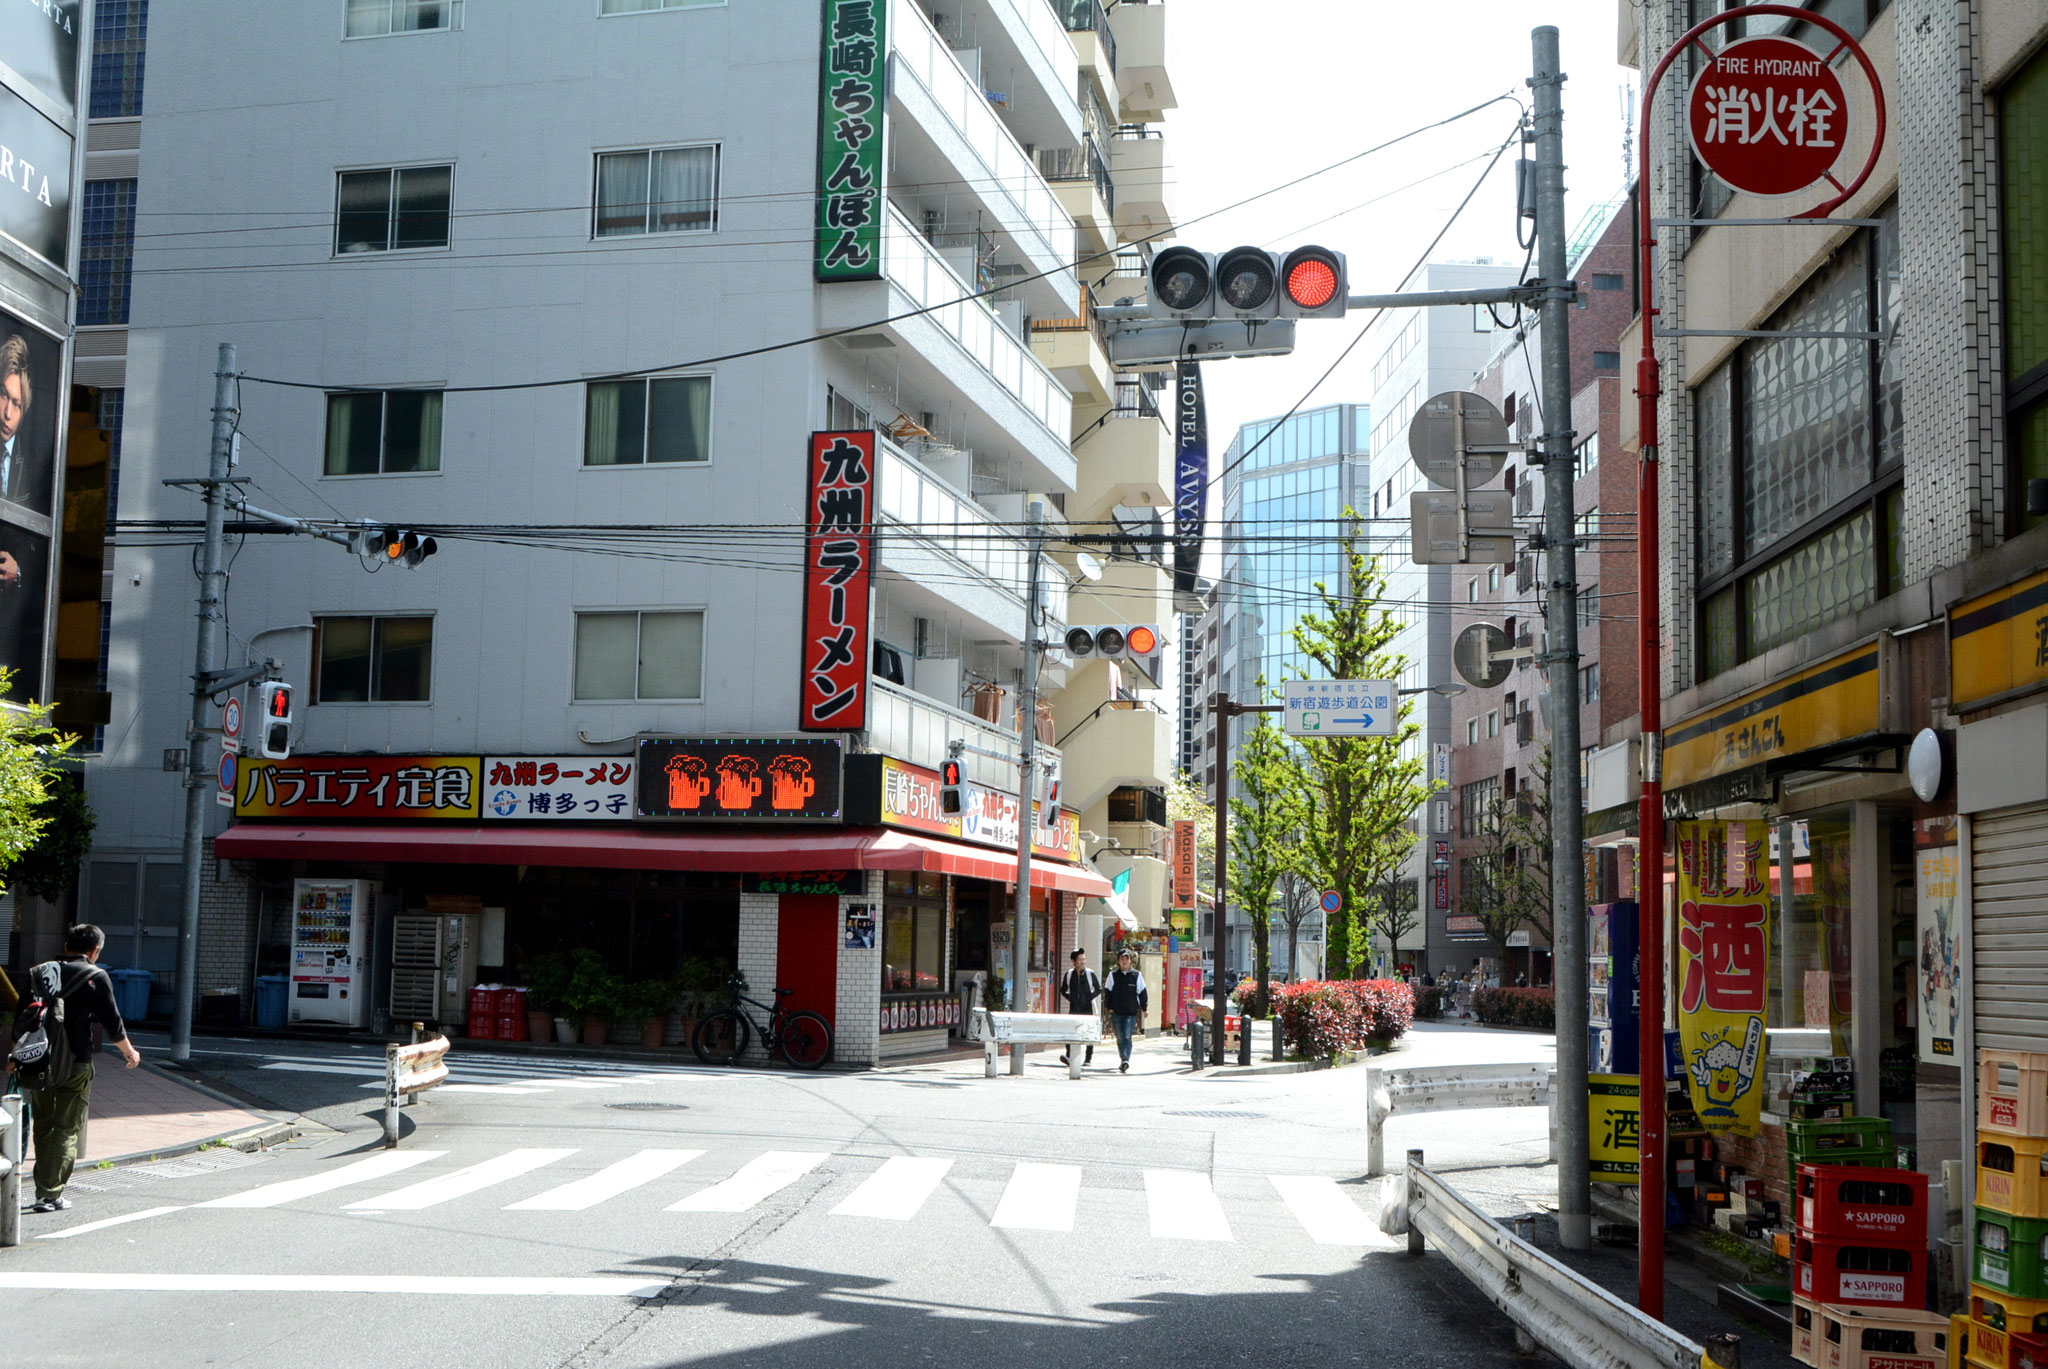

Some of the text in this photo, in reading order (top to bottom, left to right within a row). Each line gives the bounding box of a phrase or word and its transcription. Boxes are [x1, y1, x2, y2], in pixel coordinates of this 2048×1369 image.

[30, 0, 72, 35] RTA
[1717, 57, 1822, 77] FIRE HYDRANT
[1704, 85, 1837, 147] 消火栓
[825, 1, 877, 268] 長崎ちゃんぽん
[1182, 375, 1197, 447] HOTEL
[811, 437, 869, 722] 九州ラーメン
[228, 708, 238, 727] 30
[1289, 696, 1388, 710] 新宿遊歩道公園
[241, 765, 472, 809] バラエティ定食
[490, 761, 631, 786] 九州ラーメン
[528, 792, 629, 815] 博多っ子
[884, 766, 959, 826] 長崎ちゃん
[983, 789, 1019, 823] 九州ラーメ
[1183, 824, 1193, 875] Masala
[1680, 901, 1766, 1012] 酒
[19, 1046, 41, 1061] TOKYO
[1608, 1085, 1619, 1095] 24
[1603, 1109, 1640, 1151] 酒
[1985, 1173, 2011, 1197] KIRIN
[1856, 1211, 1906, 1225] SAPPORO
[1854, 1280, 1903, 1293] SAPPORO
[1977, 1327, 2004, 1357] KIRIN
